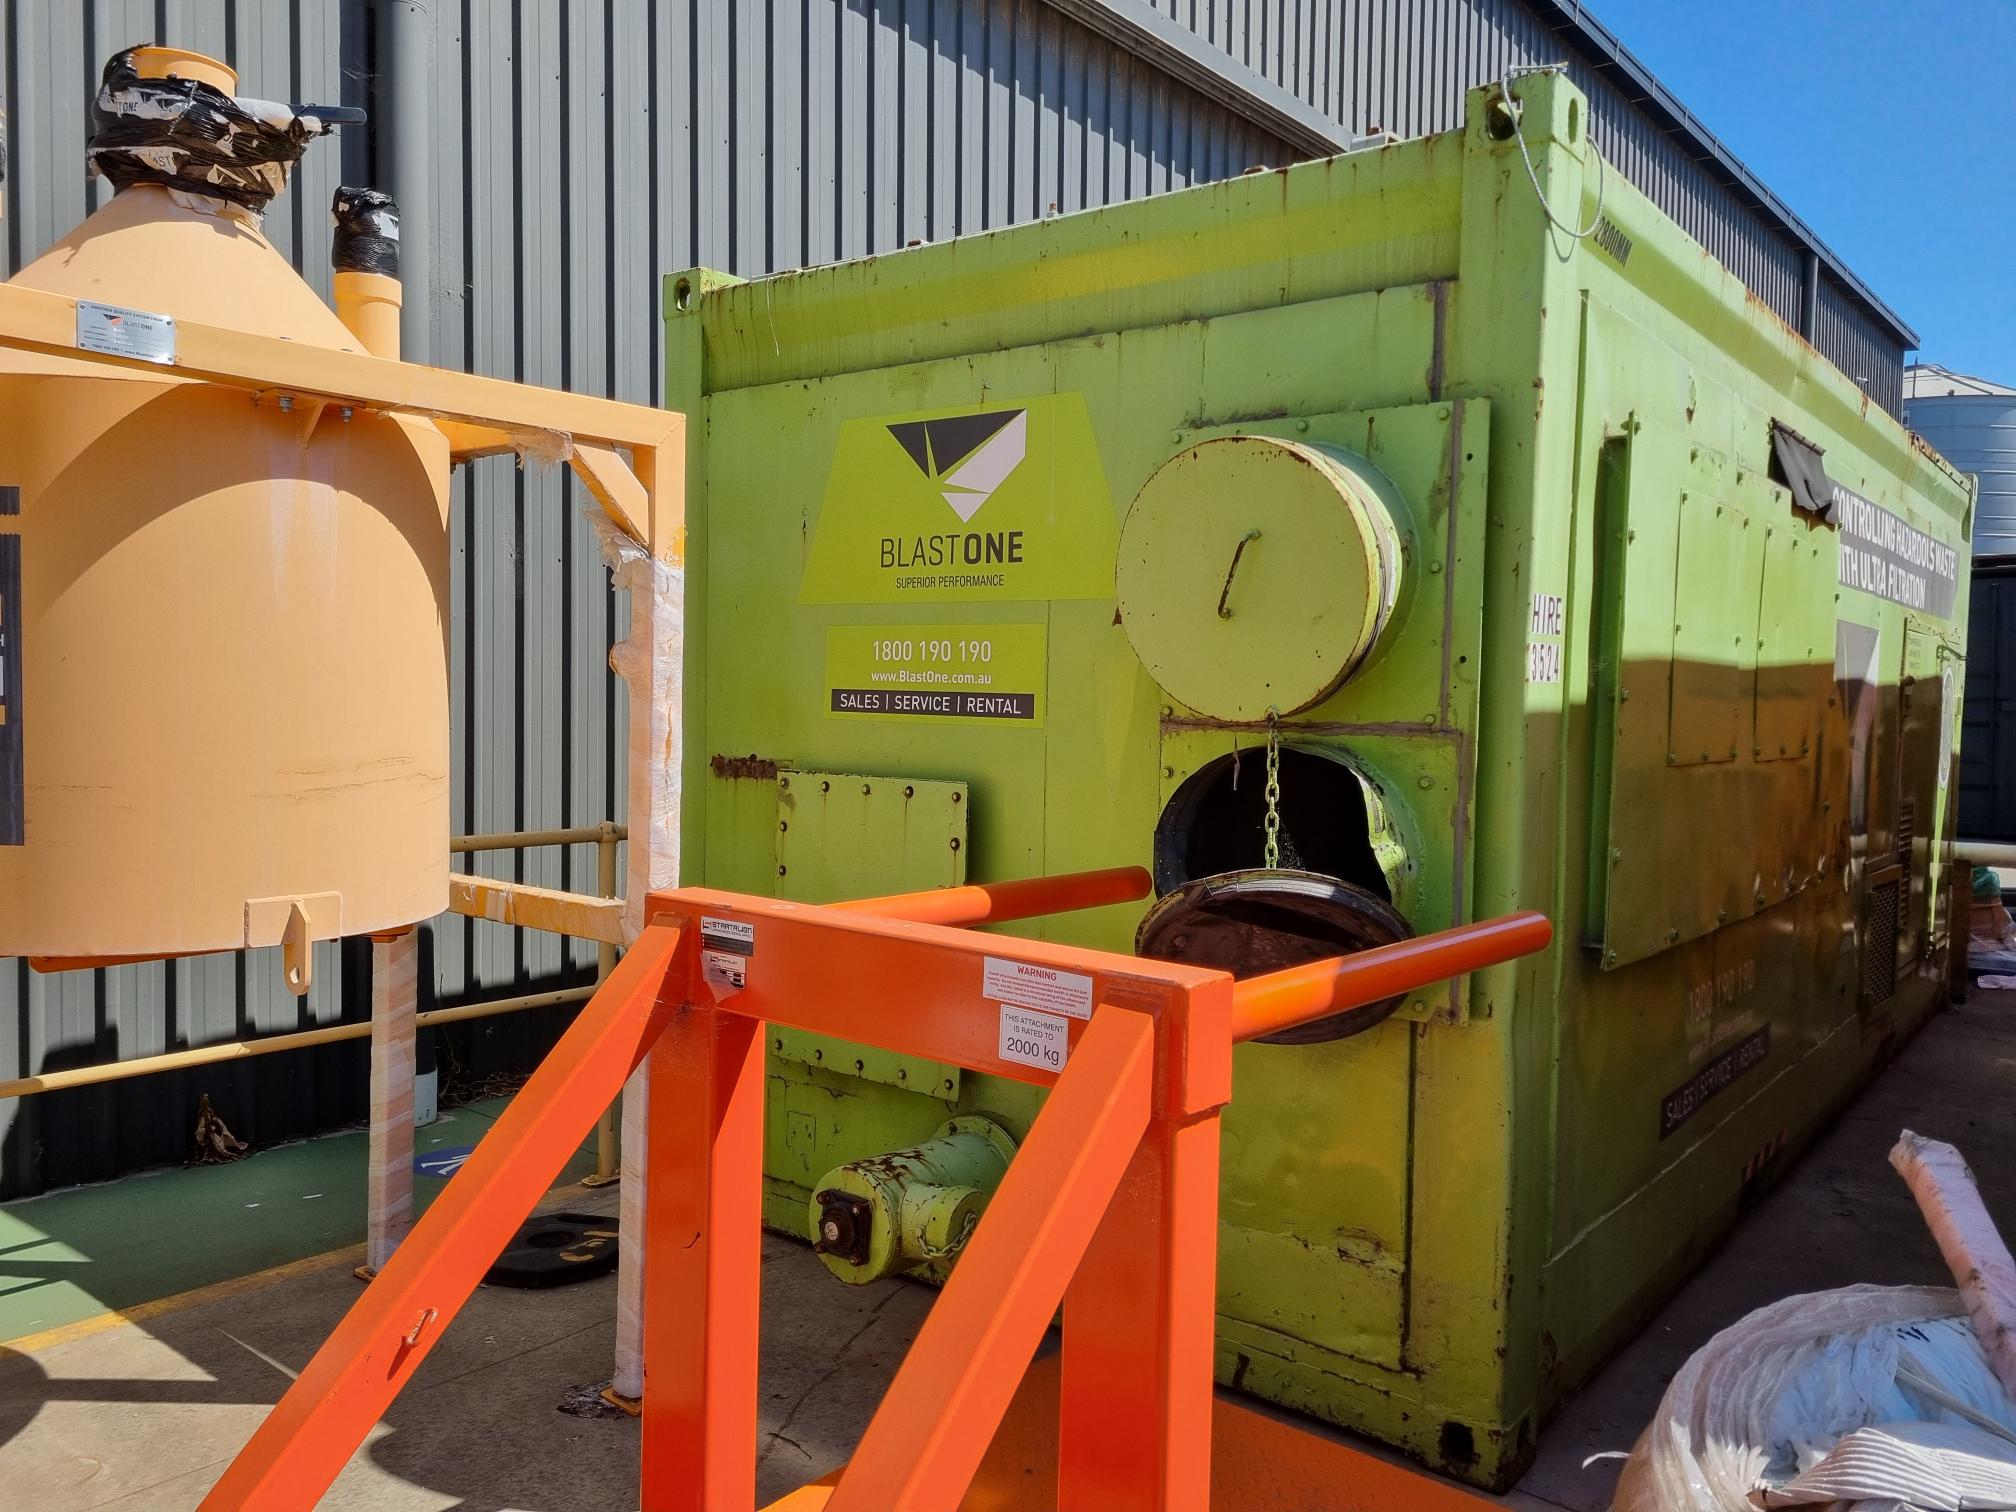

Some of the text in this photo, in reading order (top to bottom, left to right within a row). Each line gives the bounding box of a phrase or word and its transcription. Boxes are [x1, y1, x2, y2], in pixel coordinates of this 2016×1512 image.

[1593, 215, 1632, 267] 2800MM
[880, 531, 1023, 568] BLASTONE
[1935, 541, 1956, 580] WASTE
[896, 574, 1004, 589] SUPERIOR PERFORMANCE
[1840, 543, 1926, 608] ITH ULTRA FILTRATION
[1532, 594, 1562, 635] HIRE
[873, 640, 991, 662] 1800 190 190
[1531, 643, 1559, 682] 3524
[871, 670, 991, 685] www.BlastOne.com.au
[840, 693, 880, 709] SALES
[894, 695, 950, 711] SERVICE
[967, 697, 1021, 714] RENTAL
[1017, 965, 1057, 981] WARNING
[1005, 1013, 1064, 1033] THIS ATTACHMENT
[1013, 1025, 1054, 1041] IS RATED TO
[1007, 1037, 1059, 1066] 2000 kg
[1666, 1086, 1694, 1128] SALES
